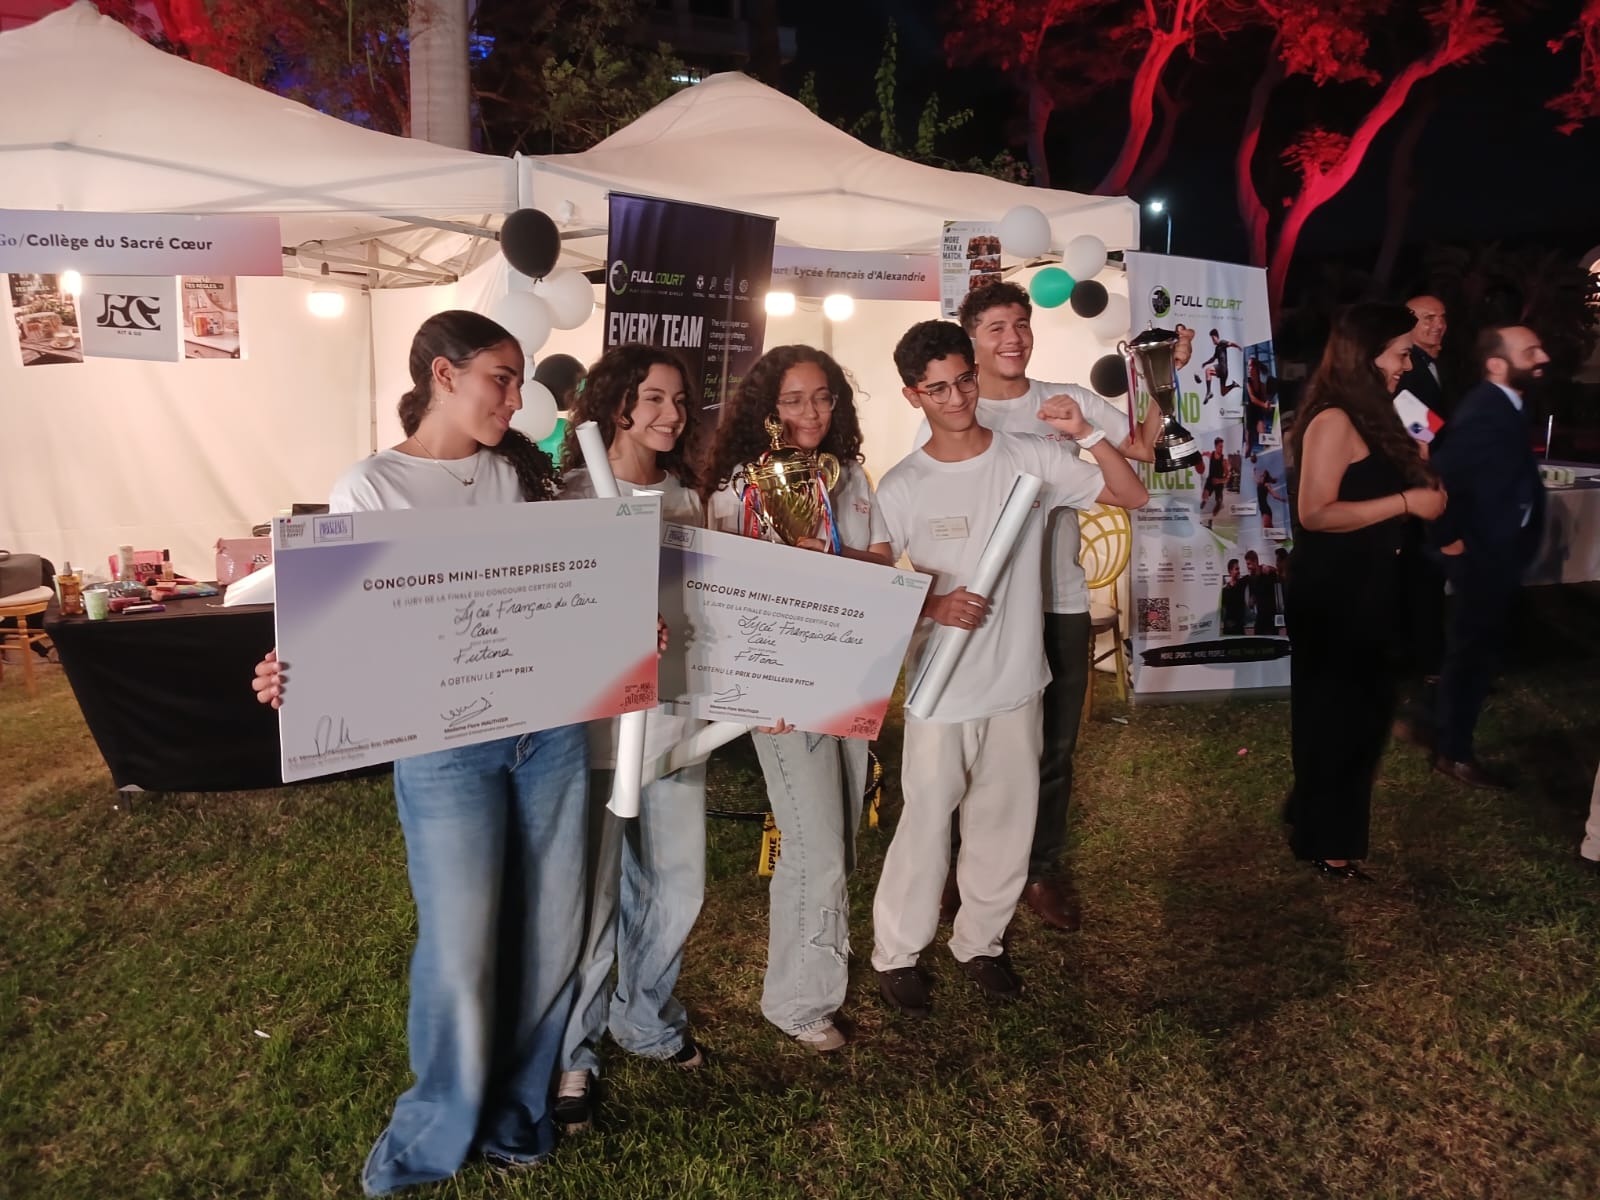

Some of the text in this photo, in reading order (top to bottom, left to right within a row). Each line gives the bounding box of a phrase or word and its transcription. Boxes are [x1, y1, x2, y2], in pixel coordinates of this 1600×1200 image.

[94, 234, 115, 248] du
[120, 236, 164, 249] Sacré
[169, 237, 213, 250] Cœur
[631, 270, 685, 286] FULL COURT
[826, 267, 865, 281] français
[867, 269, 926, 282] d'Alexandrie
[1174, 294, 1243, 310] FULL COURT
[608, 311, 704, 348] EVERY TEAM
[363, 558, 598, 592] CONCOURS MINI-ENTREPRISES 2026
[486, 586, 527, 597] CONCOURS
[686, 580, 865, 619] CONCOURS MINI-ENTREPRISES 2026
[440, 680, 447, 688] A
[448, 674, 483, 687] OBTENU
[485, 672, 494, 681] LE
[515, 665, 534, 675] PRIX
[697, 664, 724, 674] OBTENU
[735, 670, 750, 678] PRIX
[763, 674, 794, 684] MEILLEUR
[795, 678, 815, 687] PITCH
[768, 836, 777, 872] SPIKE
